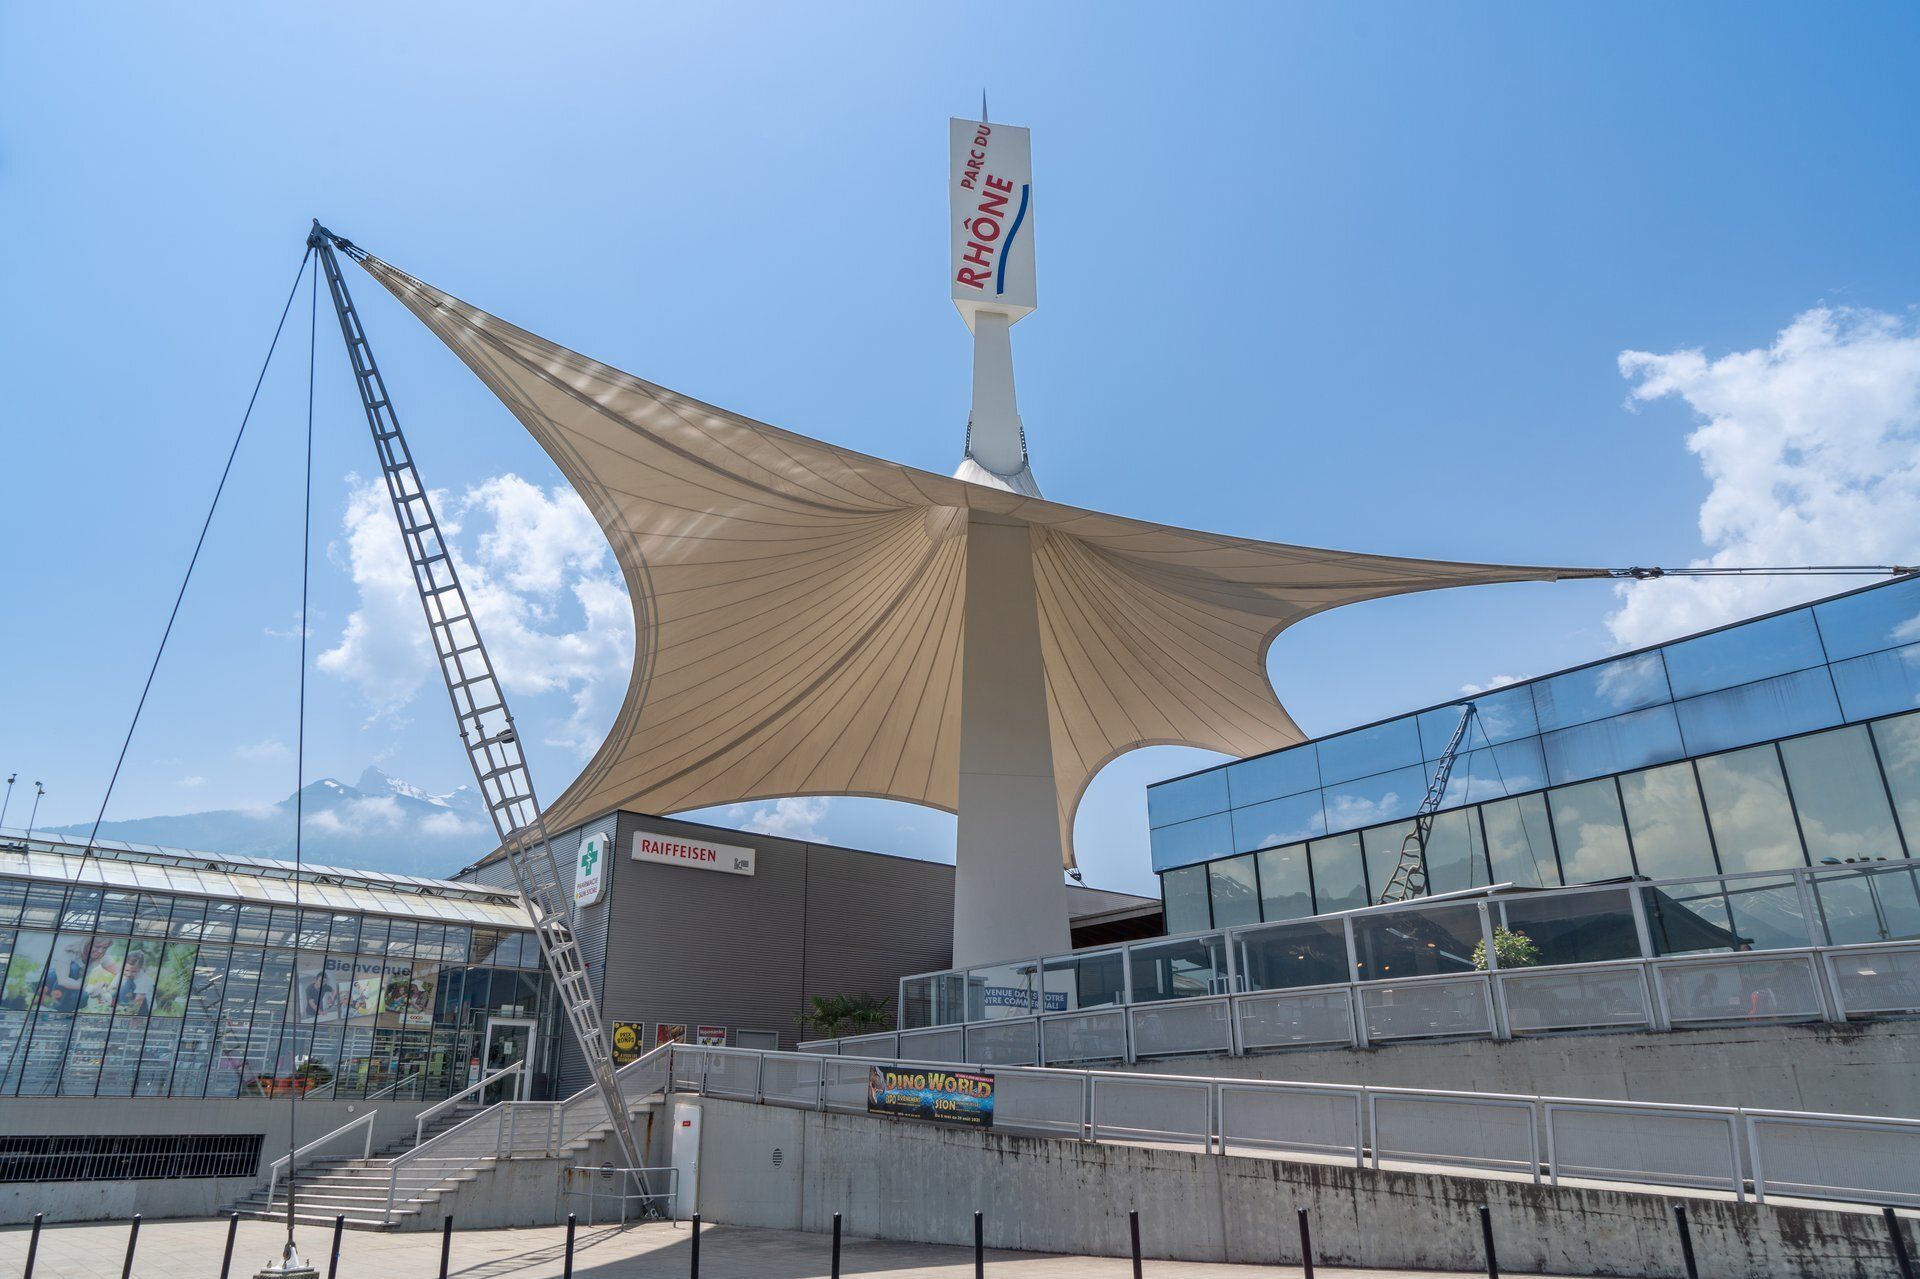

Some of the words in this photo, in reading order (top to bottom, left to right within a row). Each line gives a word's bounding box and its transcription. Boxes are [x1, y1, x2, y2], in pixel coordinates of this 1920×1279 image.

[961, 149, 985, 190] PARC
[974, 124, 991, 147] DU
[957, 174, 1014, 290] RHÔNE
[641, 838, 717, 863] RAIFFEISEN
[325, 959, 411, 976] Bienvenue
[1014, 990, 1039, 1000] DAS
[1042, 994, 1065, 1003] OTRE
[886, 1072, 926, 1091] DINO
[927, 1072, 992, 1099] WORLD
[935, 1098, 956, 1111] SION
